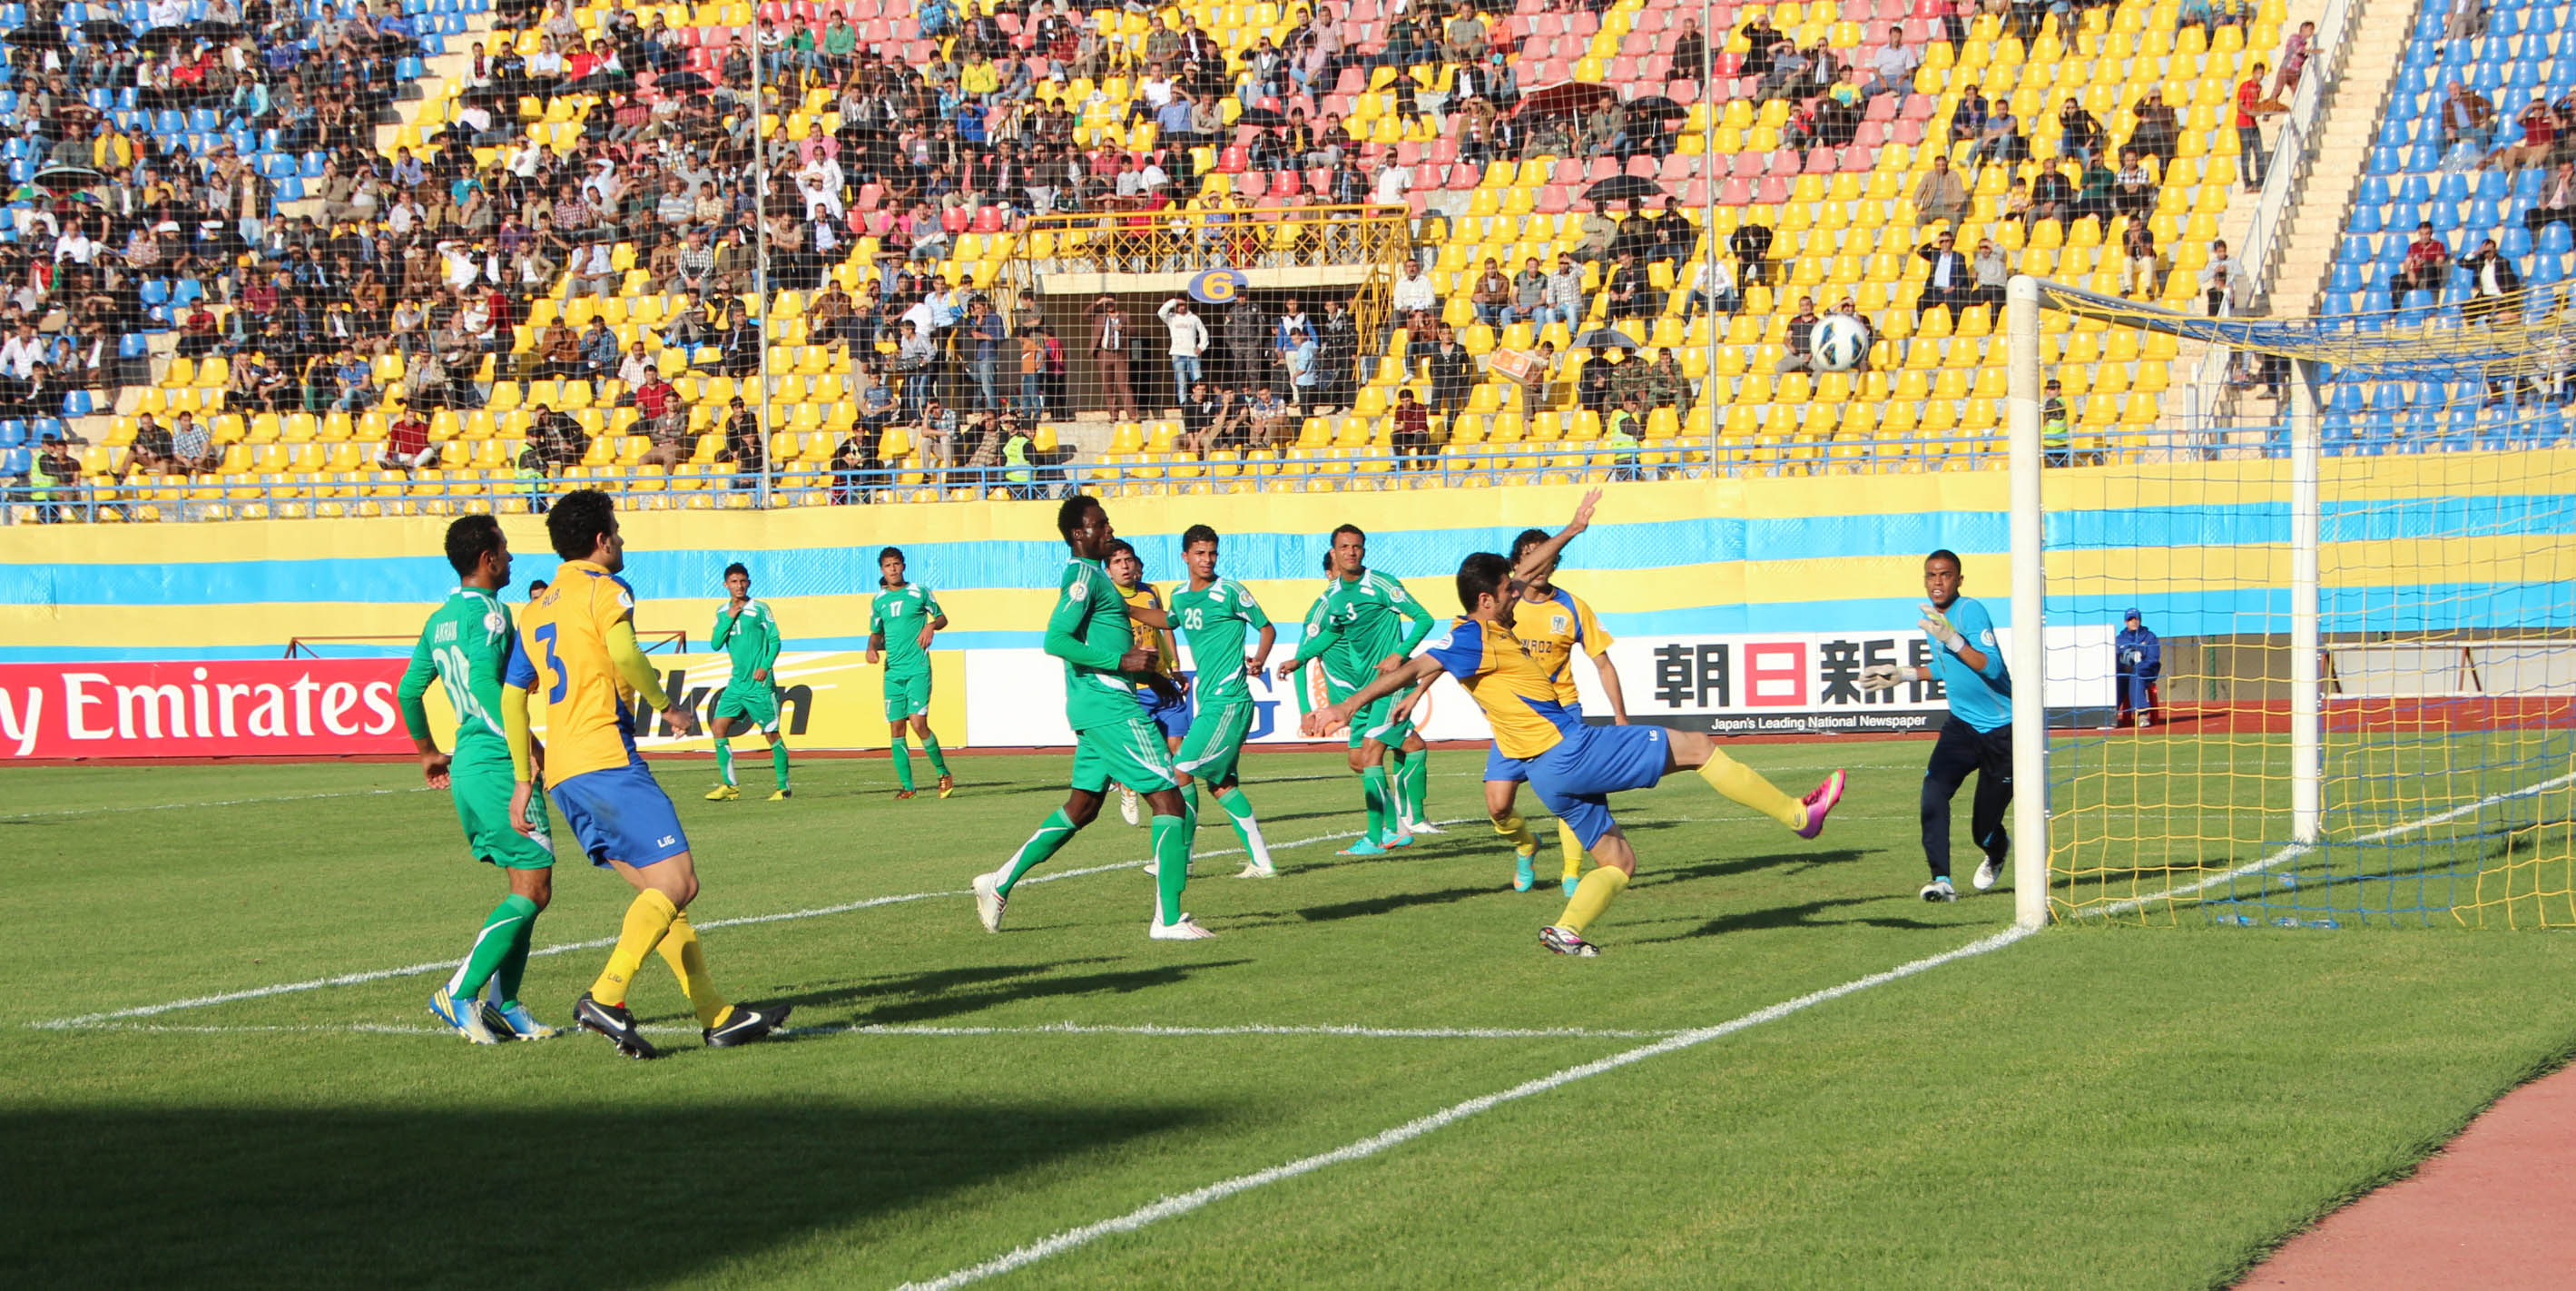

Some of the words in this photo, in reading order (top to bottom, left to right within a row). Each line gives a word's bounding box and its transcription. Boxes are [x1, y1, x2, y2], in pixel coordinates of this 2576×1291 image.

[1203, 271, 1234, 300] 6
[890, 600, 903, 617] 17
[1346, 602, 1357, 621] 3
[1185, 608, 1203, 630] 26
[535, 622, 568, 705] 3
[61, 666, 397, 741] Emirates
[1711, 717, 1755, 732] Japan's
[1758, 716, 1805, 731] Leading
[1808, 715, 1856, 728] National
[1860, 714, 1927, 729] Newspaper
[656, 834, 676, 849] LIG
